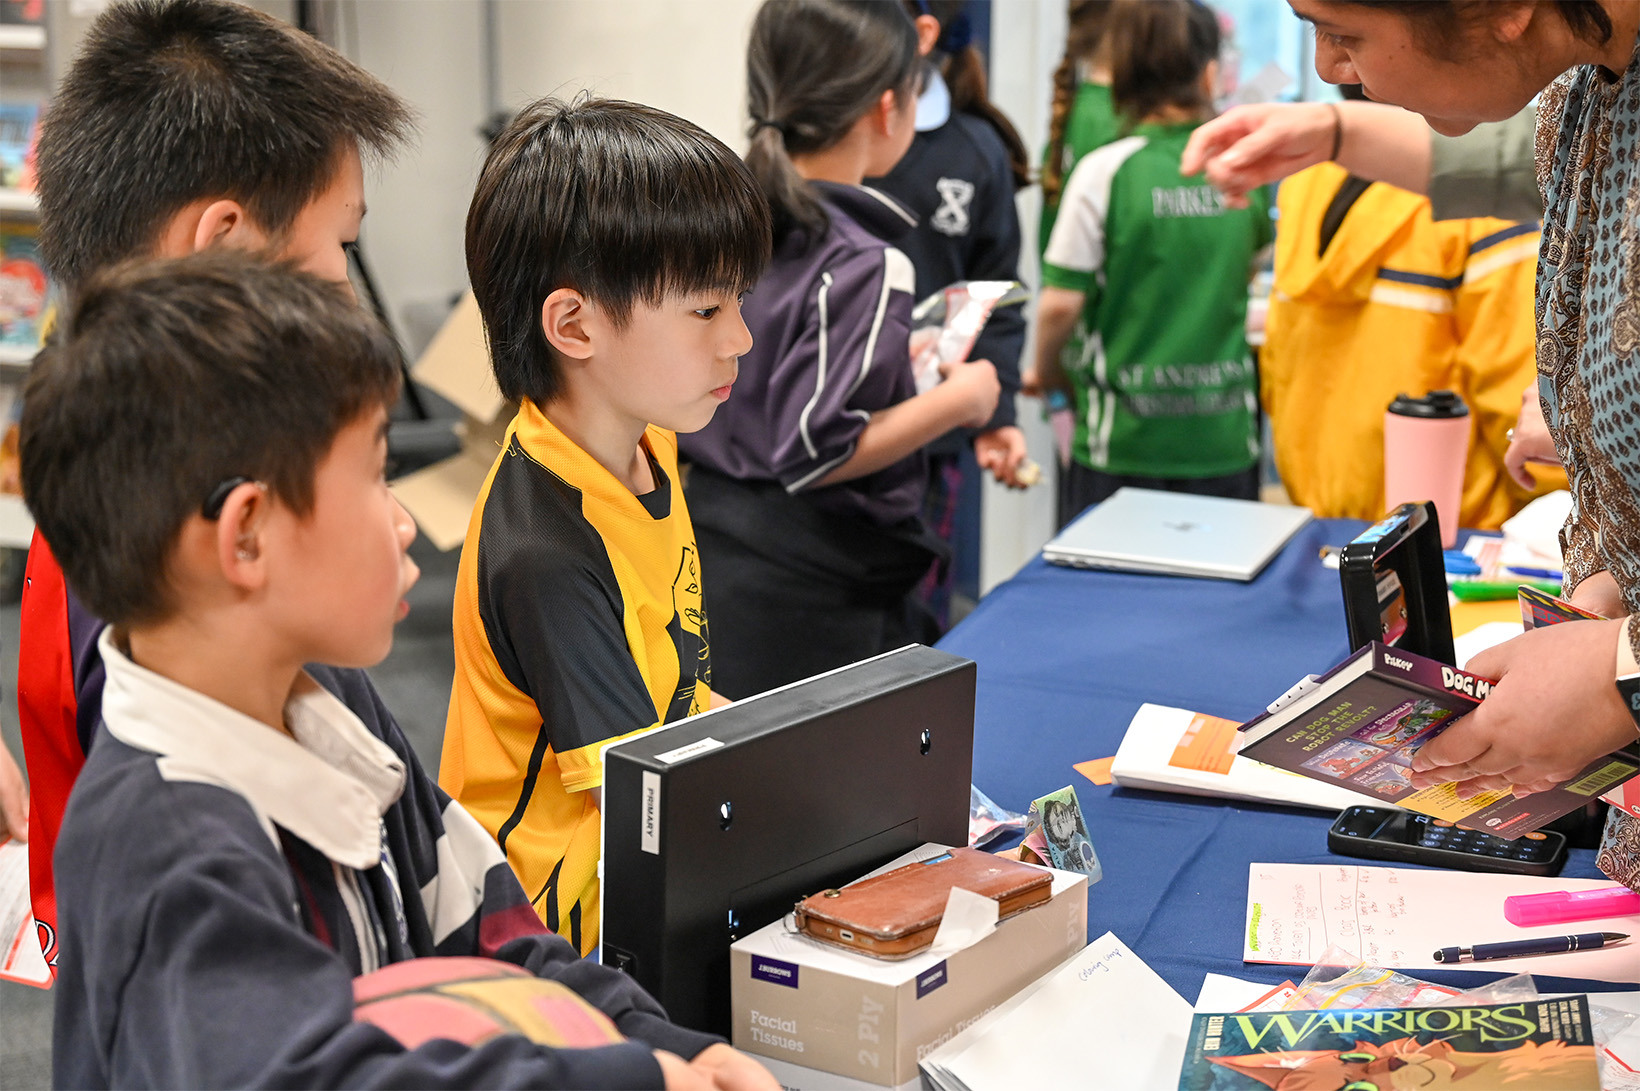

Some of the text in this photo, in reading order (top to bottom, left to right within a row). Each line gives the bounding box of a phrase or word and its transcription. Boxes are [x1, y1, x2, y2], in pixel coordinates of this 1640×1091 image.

[1533, 607, 1566, 622] SP
[1441, 666, 1474, 696] DOG
[1286, 701, 1352, 743] CAN DOG MAN
[1302, 705, 1377, 752] ROBOT REVOLT?
[1305, 711, 1354, 741] STOP THE
[646, 787, 654, 838] PRIMARY
[750, 1010, 797, 1034] Facial
[751, 1026, 804, 1053] Tissues
[858, 996, 884, 1069] 2 Ply
[1230, 1003, 1537, 1050] WARRIORS
